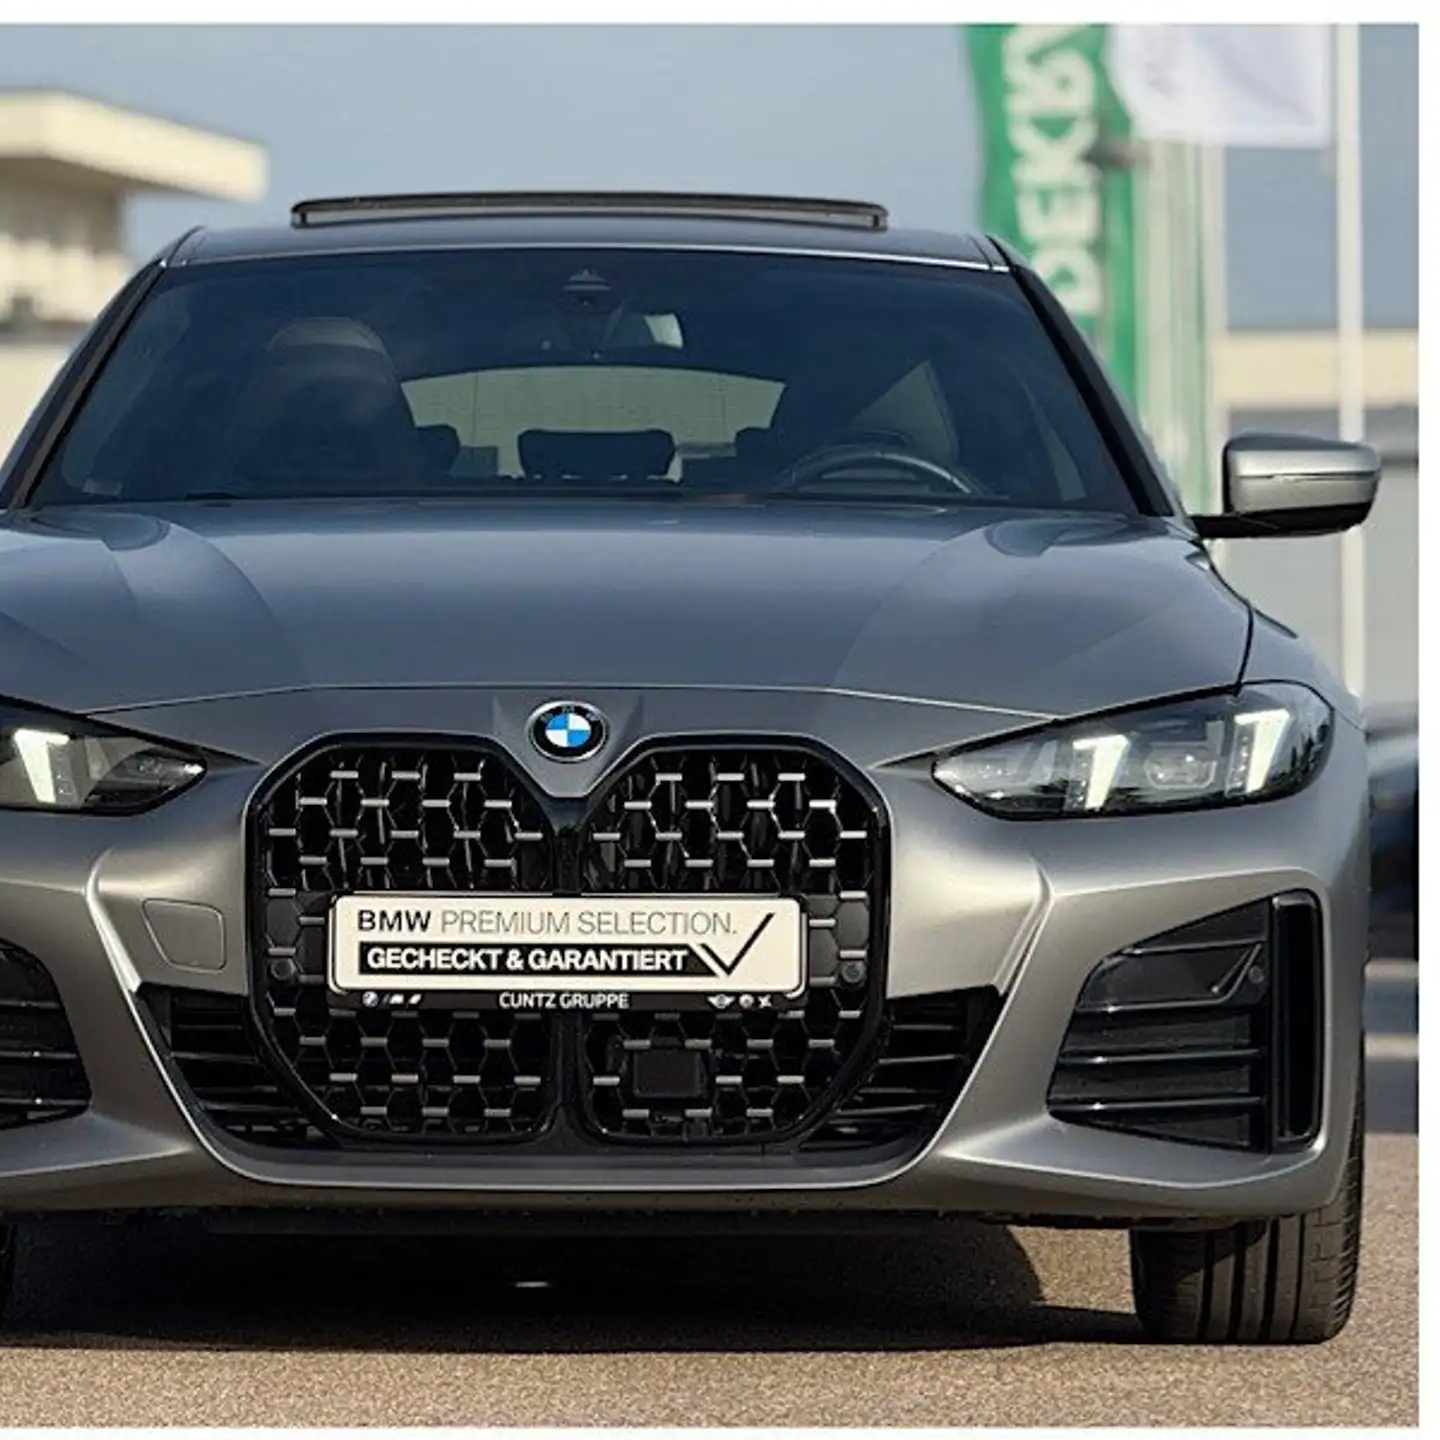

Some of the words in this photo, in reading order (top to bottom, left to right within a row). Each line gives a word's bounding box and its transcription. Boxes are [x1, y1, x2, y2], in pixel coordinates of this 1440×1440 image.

[357, 909, 432, 934] BMW
[441, 910, 570, 935] PREMIUM
[577, 911, 738, 935] SELECTION.
[367, 947, 503, 970] GECHECKT
[506, 948, 524, 970] &
[528, 948, 689, 971] GARANTIERT
[499, 991, 557, 1009] CUNTZ
[559, 991, 630, 1009] GRUPPE
